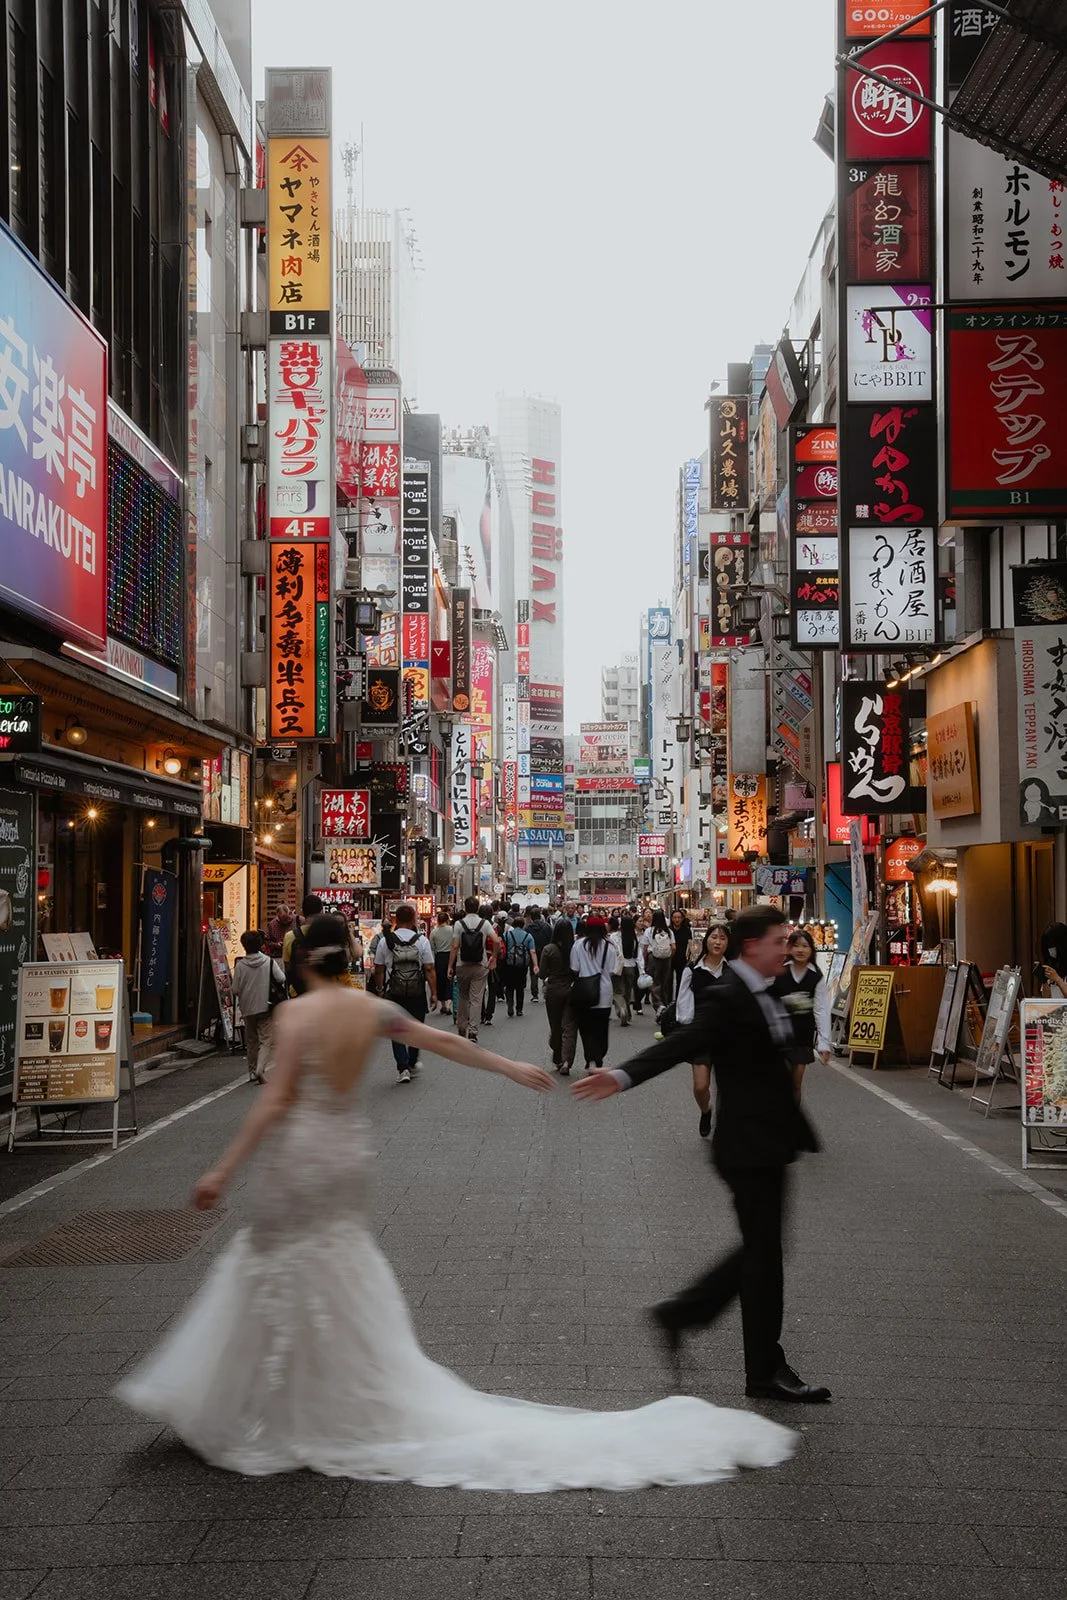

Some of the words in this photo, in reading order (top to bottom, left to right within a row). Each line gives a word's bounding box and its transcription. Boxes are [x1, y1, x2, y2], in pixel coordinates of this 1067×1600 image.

[849, 168, 867, 182] 3F
[278, 177, 304, 304] ヤマネ肉店
[307, 176, 321, 263] やきとん酒場
[874, 173, 903, 272] 龍幻酒家
[972, 188, 984, 285] 創業昭和二十九年
[1005, 166, 1031, 281] ホルモン
[285, 314, 316, 330] B1F
[274, 342, 328, 477] 熟女キャバクラ
[987, 335, 1051, 485] ステップ
[1010, 492, 1030, 504] B1
[285, 519, 315, 536] 4F
[317, 548, 329, 595] 炭火串焼
[899, 529, 929, 618] 居酒屋
[855, 602, 868, 642] 一番街
[905, 629, 933, 642] B1F
[108, 641, 144, 681] YAKINIKU
[1021, 639, 1035, 696] HIROSHIMA
[324, 793, 366, 814] 湖南
[454, 731, 469, 846] とんにいむら
[530, 829, 563, 841] SAUNA
[852, 1021, 880, 1039] 290円
